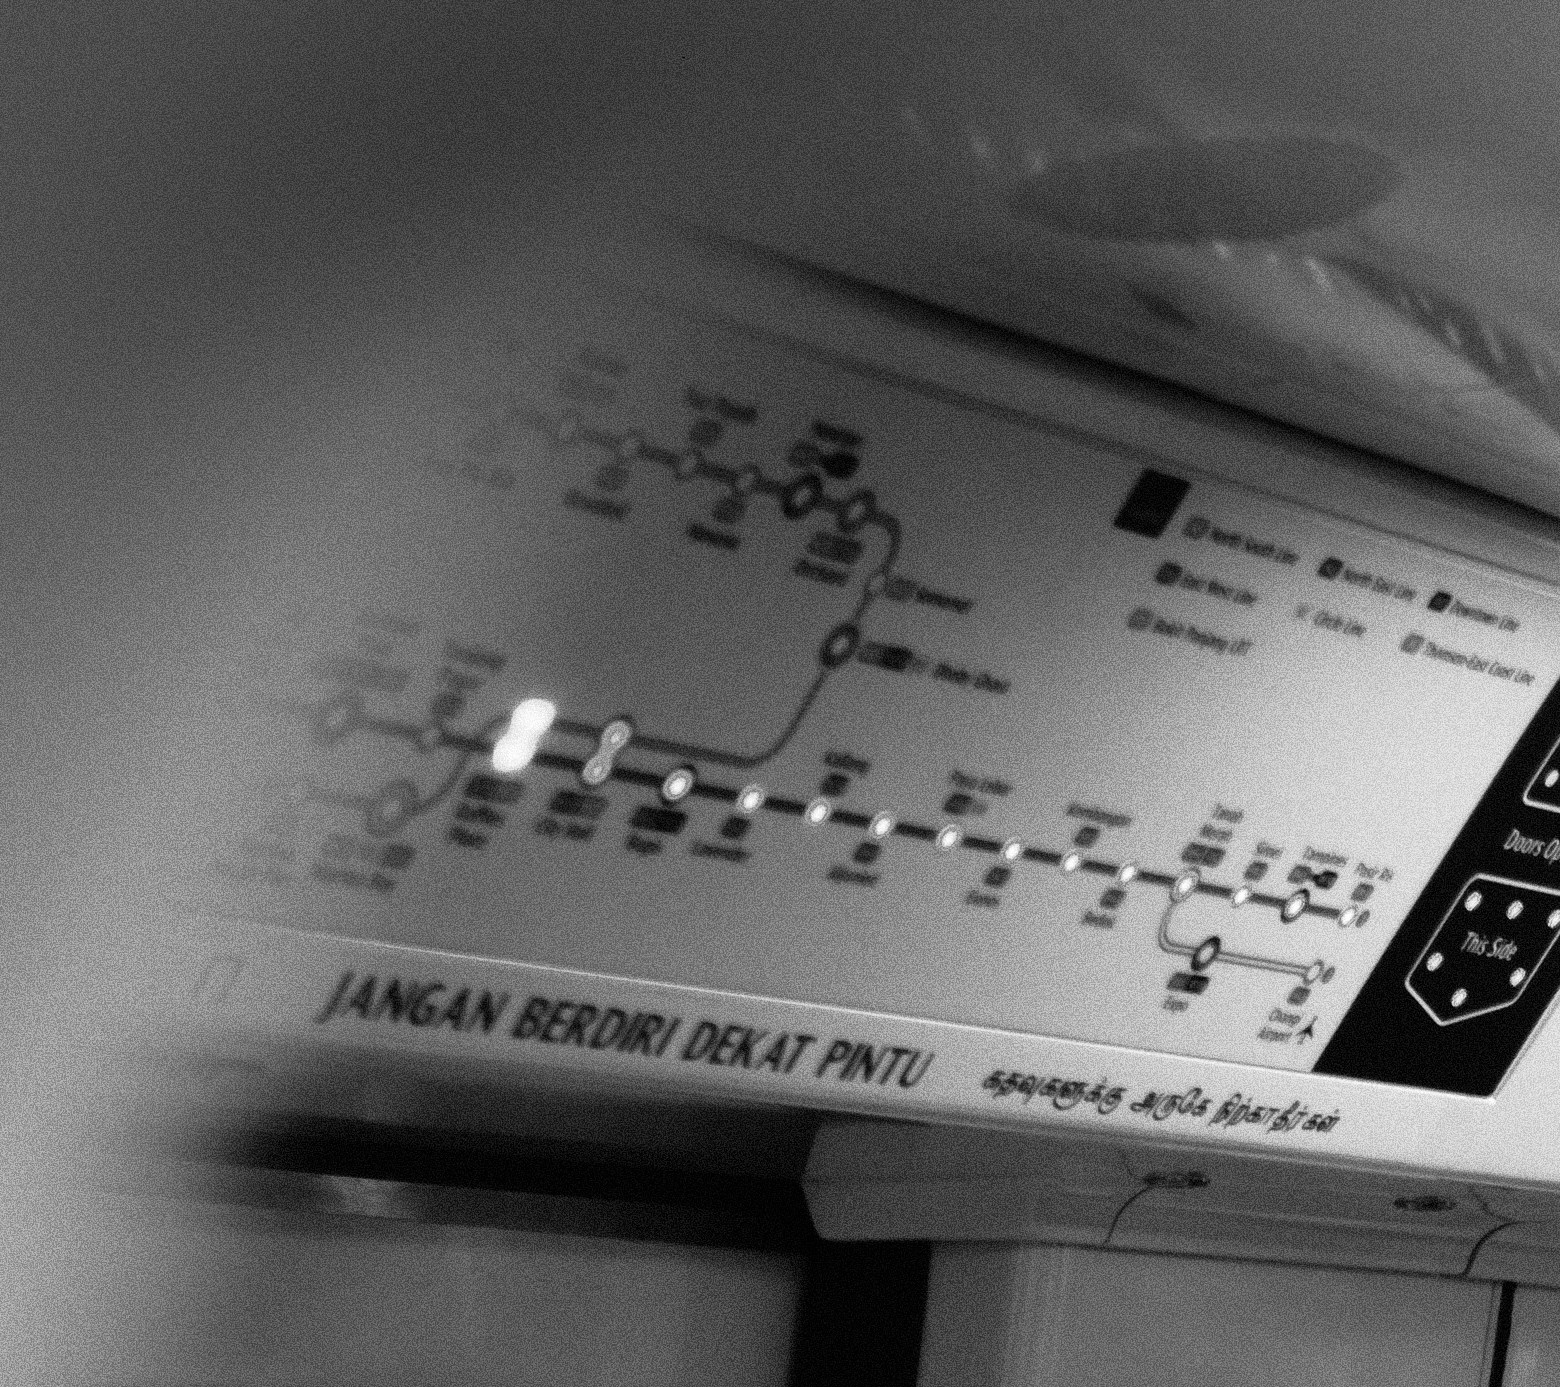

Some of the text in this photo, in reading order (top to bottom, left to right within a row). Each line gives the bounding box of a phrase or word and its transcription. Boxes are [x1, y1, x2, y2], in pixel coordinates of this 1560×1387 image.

[1503, 829, 1546, 857] Doors
[1461, 931, 1518, 962] This Side
[314, 970, 509, 1034] JANGAN
[511, 996, 681, 1057] BERDIRI
[681, 1020, 817, 1075] DEKAT
[816, 1038, 937, 1090] PINTU
